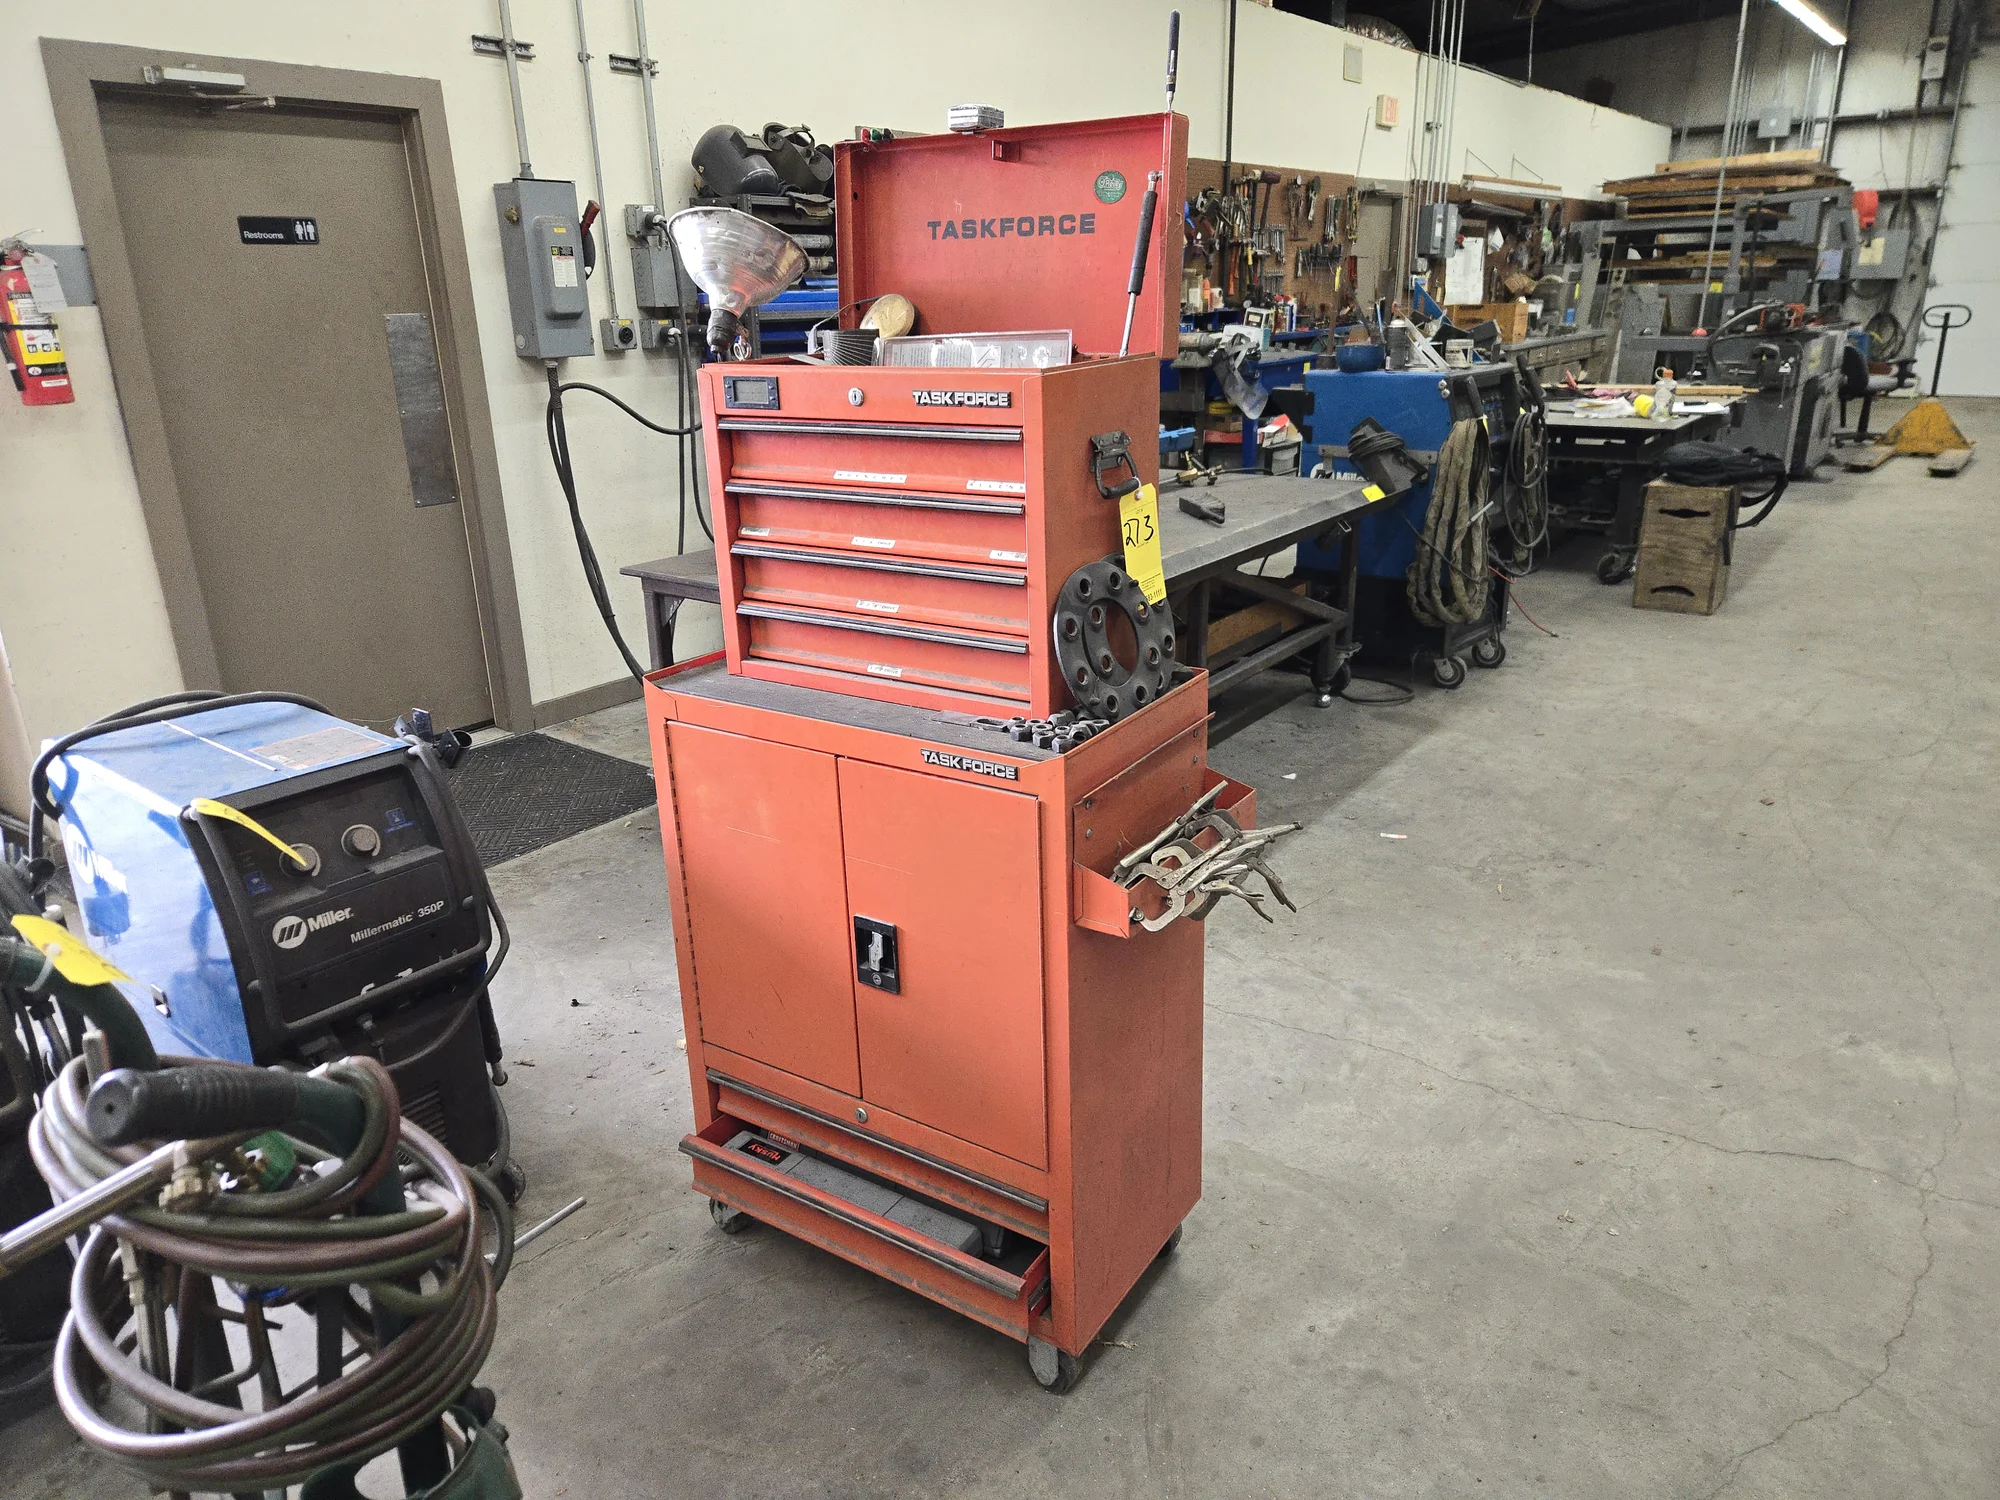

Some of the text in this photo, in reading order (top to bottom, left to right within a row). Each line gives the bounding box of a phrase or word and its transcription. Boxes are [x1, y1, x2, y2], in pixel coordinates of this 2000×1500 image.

[243, 230, 284, 239] Restrooms
[927, 213, 1096, 241] TASKFORCE
[1335, 471, 1370, 481] Mille
[1123, 514, 1154, 547] 273
[308, 907, 352, 932] Miller
[350, 900, 445, 944] Millermatic 350P
